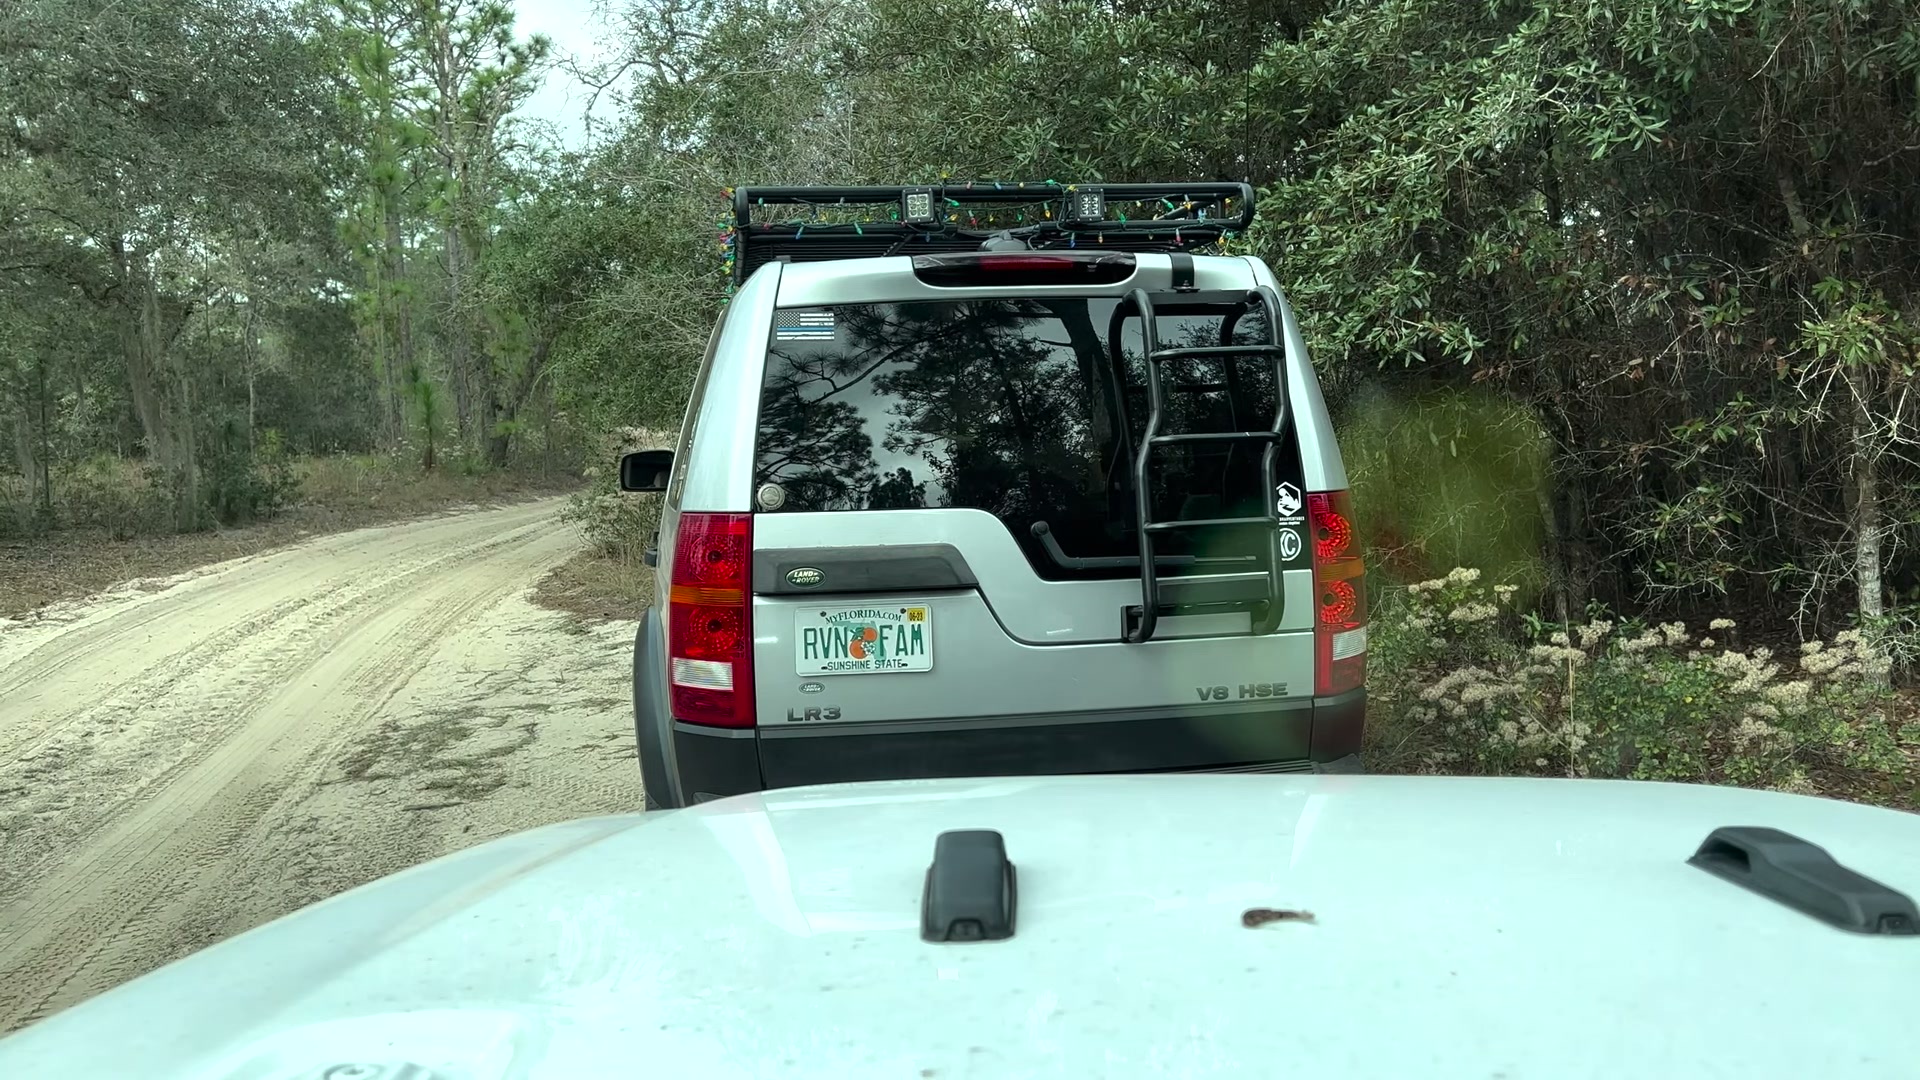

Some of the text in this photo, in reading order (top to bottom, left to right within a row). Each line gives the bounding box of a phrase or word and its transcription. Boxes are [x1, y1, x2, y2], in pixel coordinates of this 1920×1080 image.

[794, 570, 814, 578] LAND
[795, 576, 820, 584] ROVER
[825, 610, 902, 624] MYFLORIDA.COM
[804, 623, 925, 659] RVN FAM
[827, 658, 903, 671] SUNSHINE STATE
[1196, 681, 1289, 701] V8 HSE
[787, 706, 842, 722] LR3
